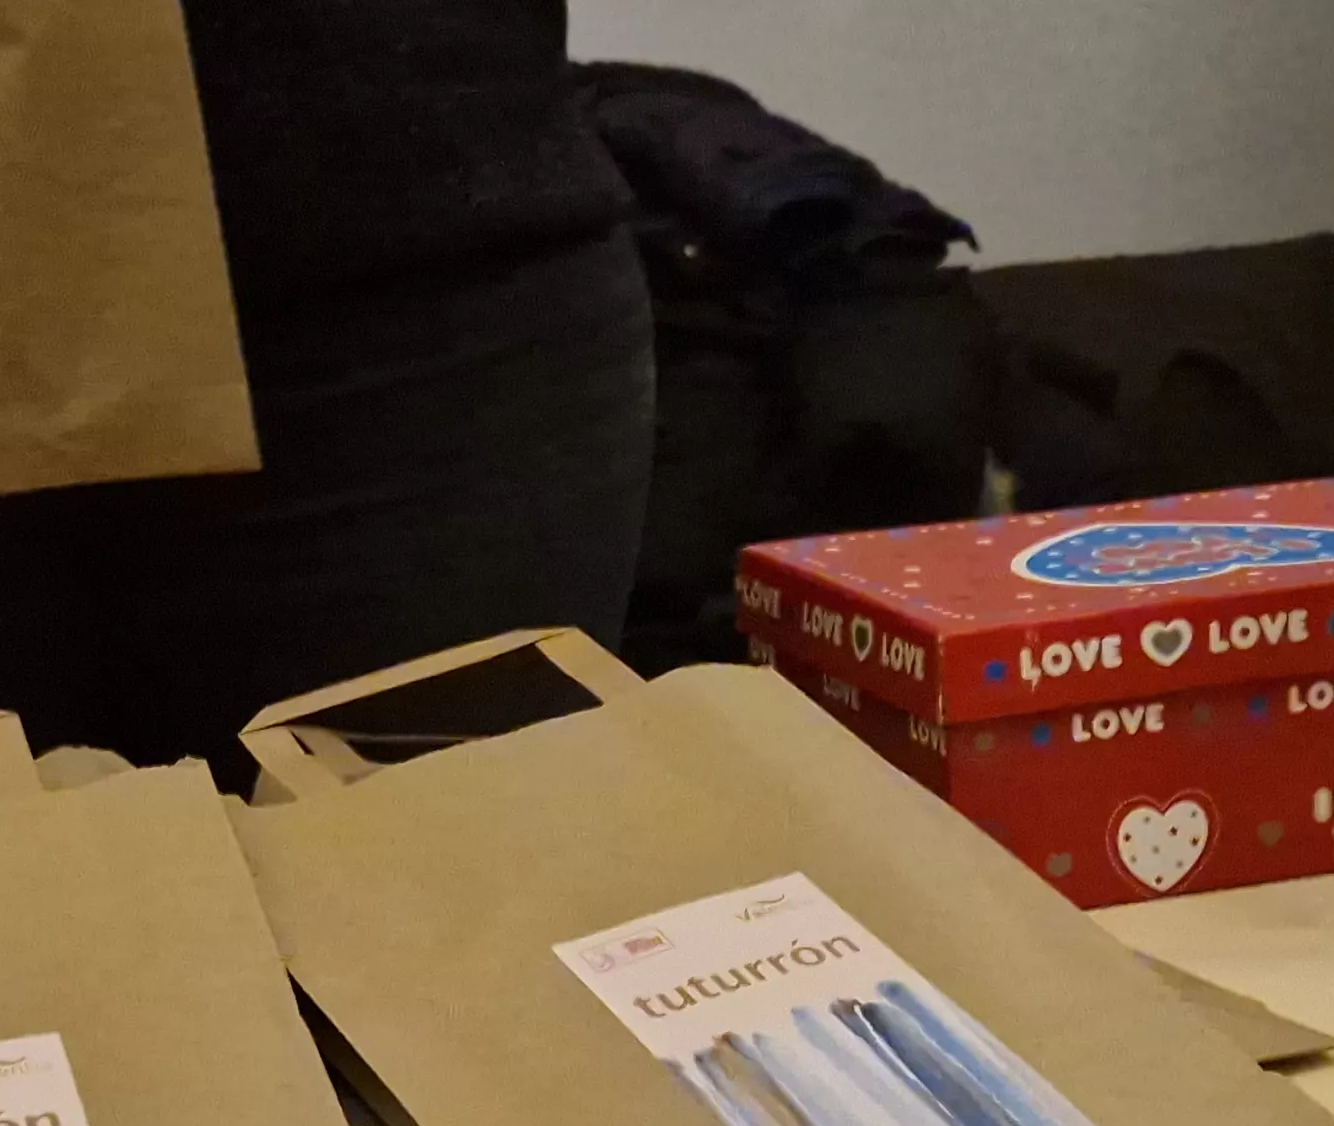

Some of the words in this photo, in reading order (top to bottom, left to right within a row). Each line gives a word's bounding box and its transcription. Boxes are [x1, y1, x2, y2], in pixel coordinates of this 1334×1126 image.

[881, 632, 926, 680] LOVE
[1019, 634, 1123, 681] LOVE
[1208, 608, 1309, 654] LOVE
[1071, 703, 1165, 743] LOVE
[633, 933, 861, 1018] tuturrón
